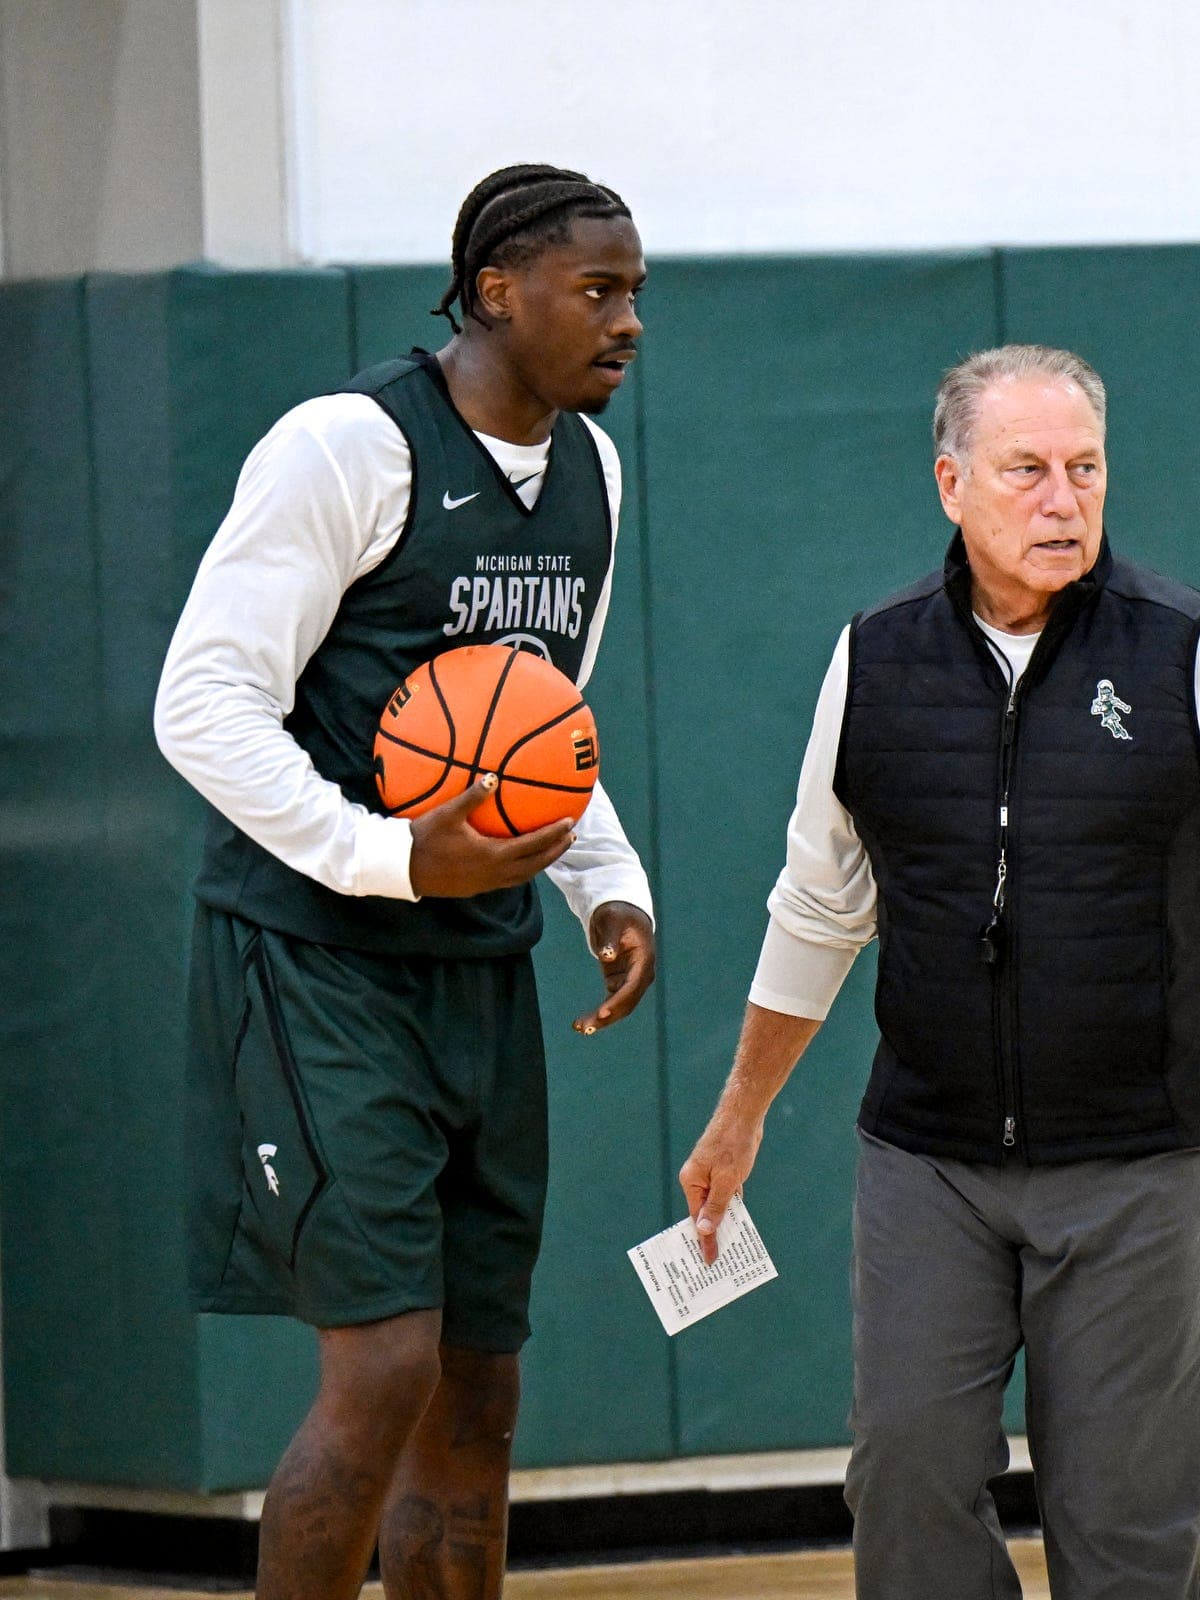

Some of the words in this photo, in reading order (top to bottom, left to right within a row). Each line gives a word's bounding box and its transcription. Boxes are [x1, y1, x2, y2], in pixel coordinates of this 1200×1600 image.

[476, 555, 532, 572] MICHIGAN
[537, 555, 572, 572] STATE
[442, 576, 586, 640] SPARTANS
